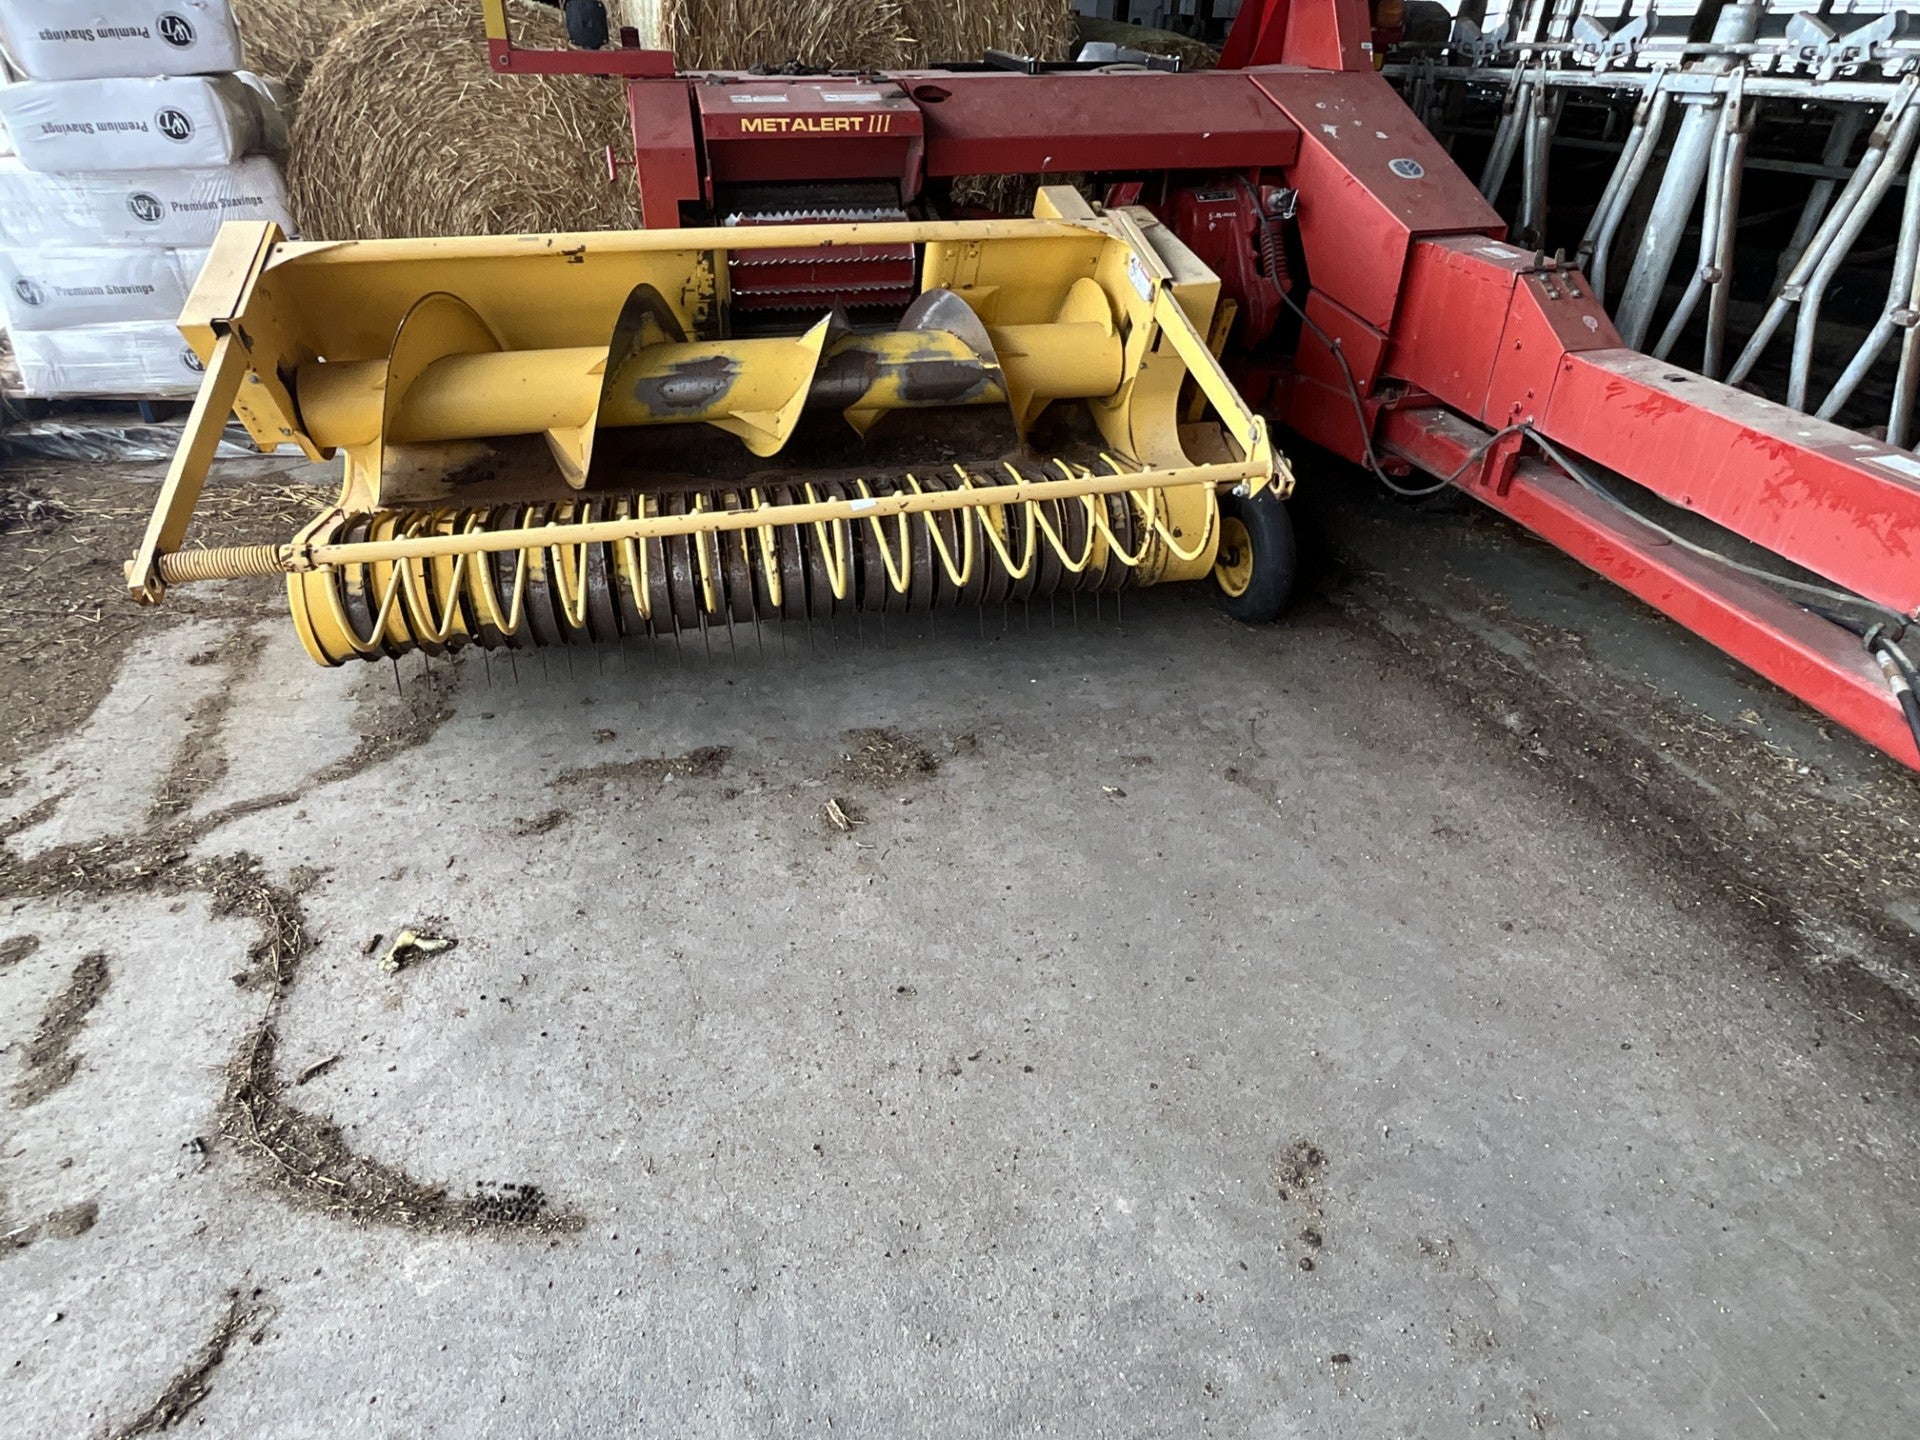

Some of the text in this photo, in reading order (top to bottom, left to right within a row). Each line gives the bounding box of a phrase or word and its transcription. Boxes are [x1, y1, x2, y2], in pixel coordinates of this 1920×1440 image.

[39, 26, 150, 43] Premium Shavings
[41, 120, 149, 135] Premium Shavings
[741, 114, 891, 133] METALERT III
[171, 195, 264, 212] Premium Shavings
[53, 283, 155, 297] Premium Shavings
